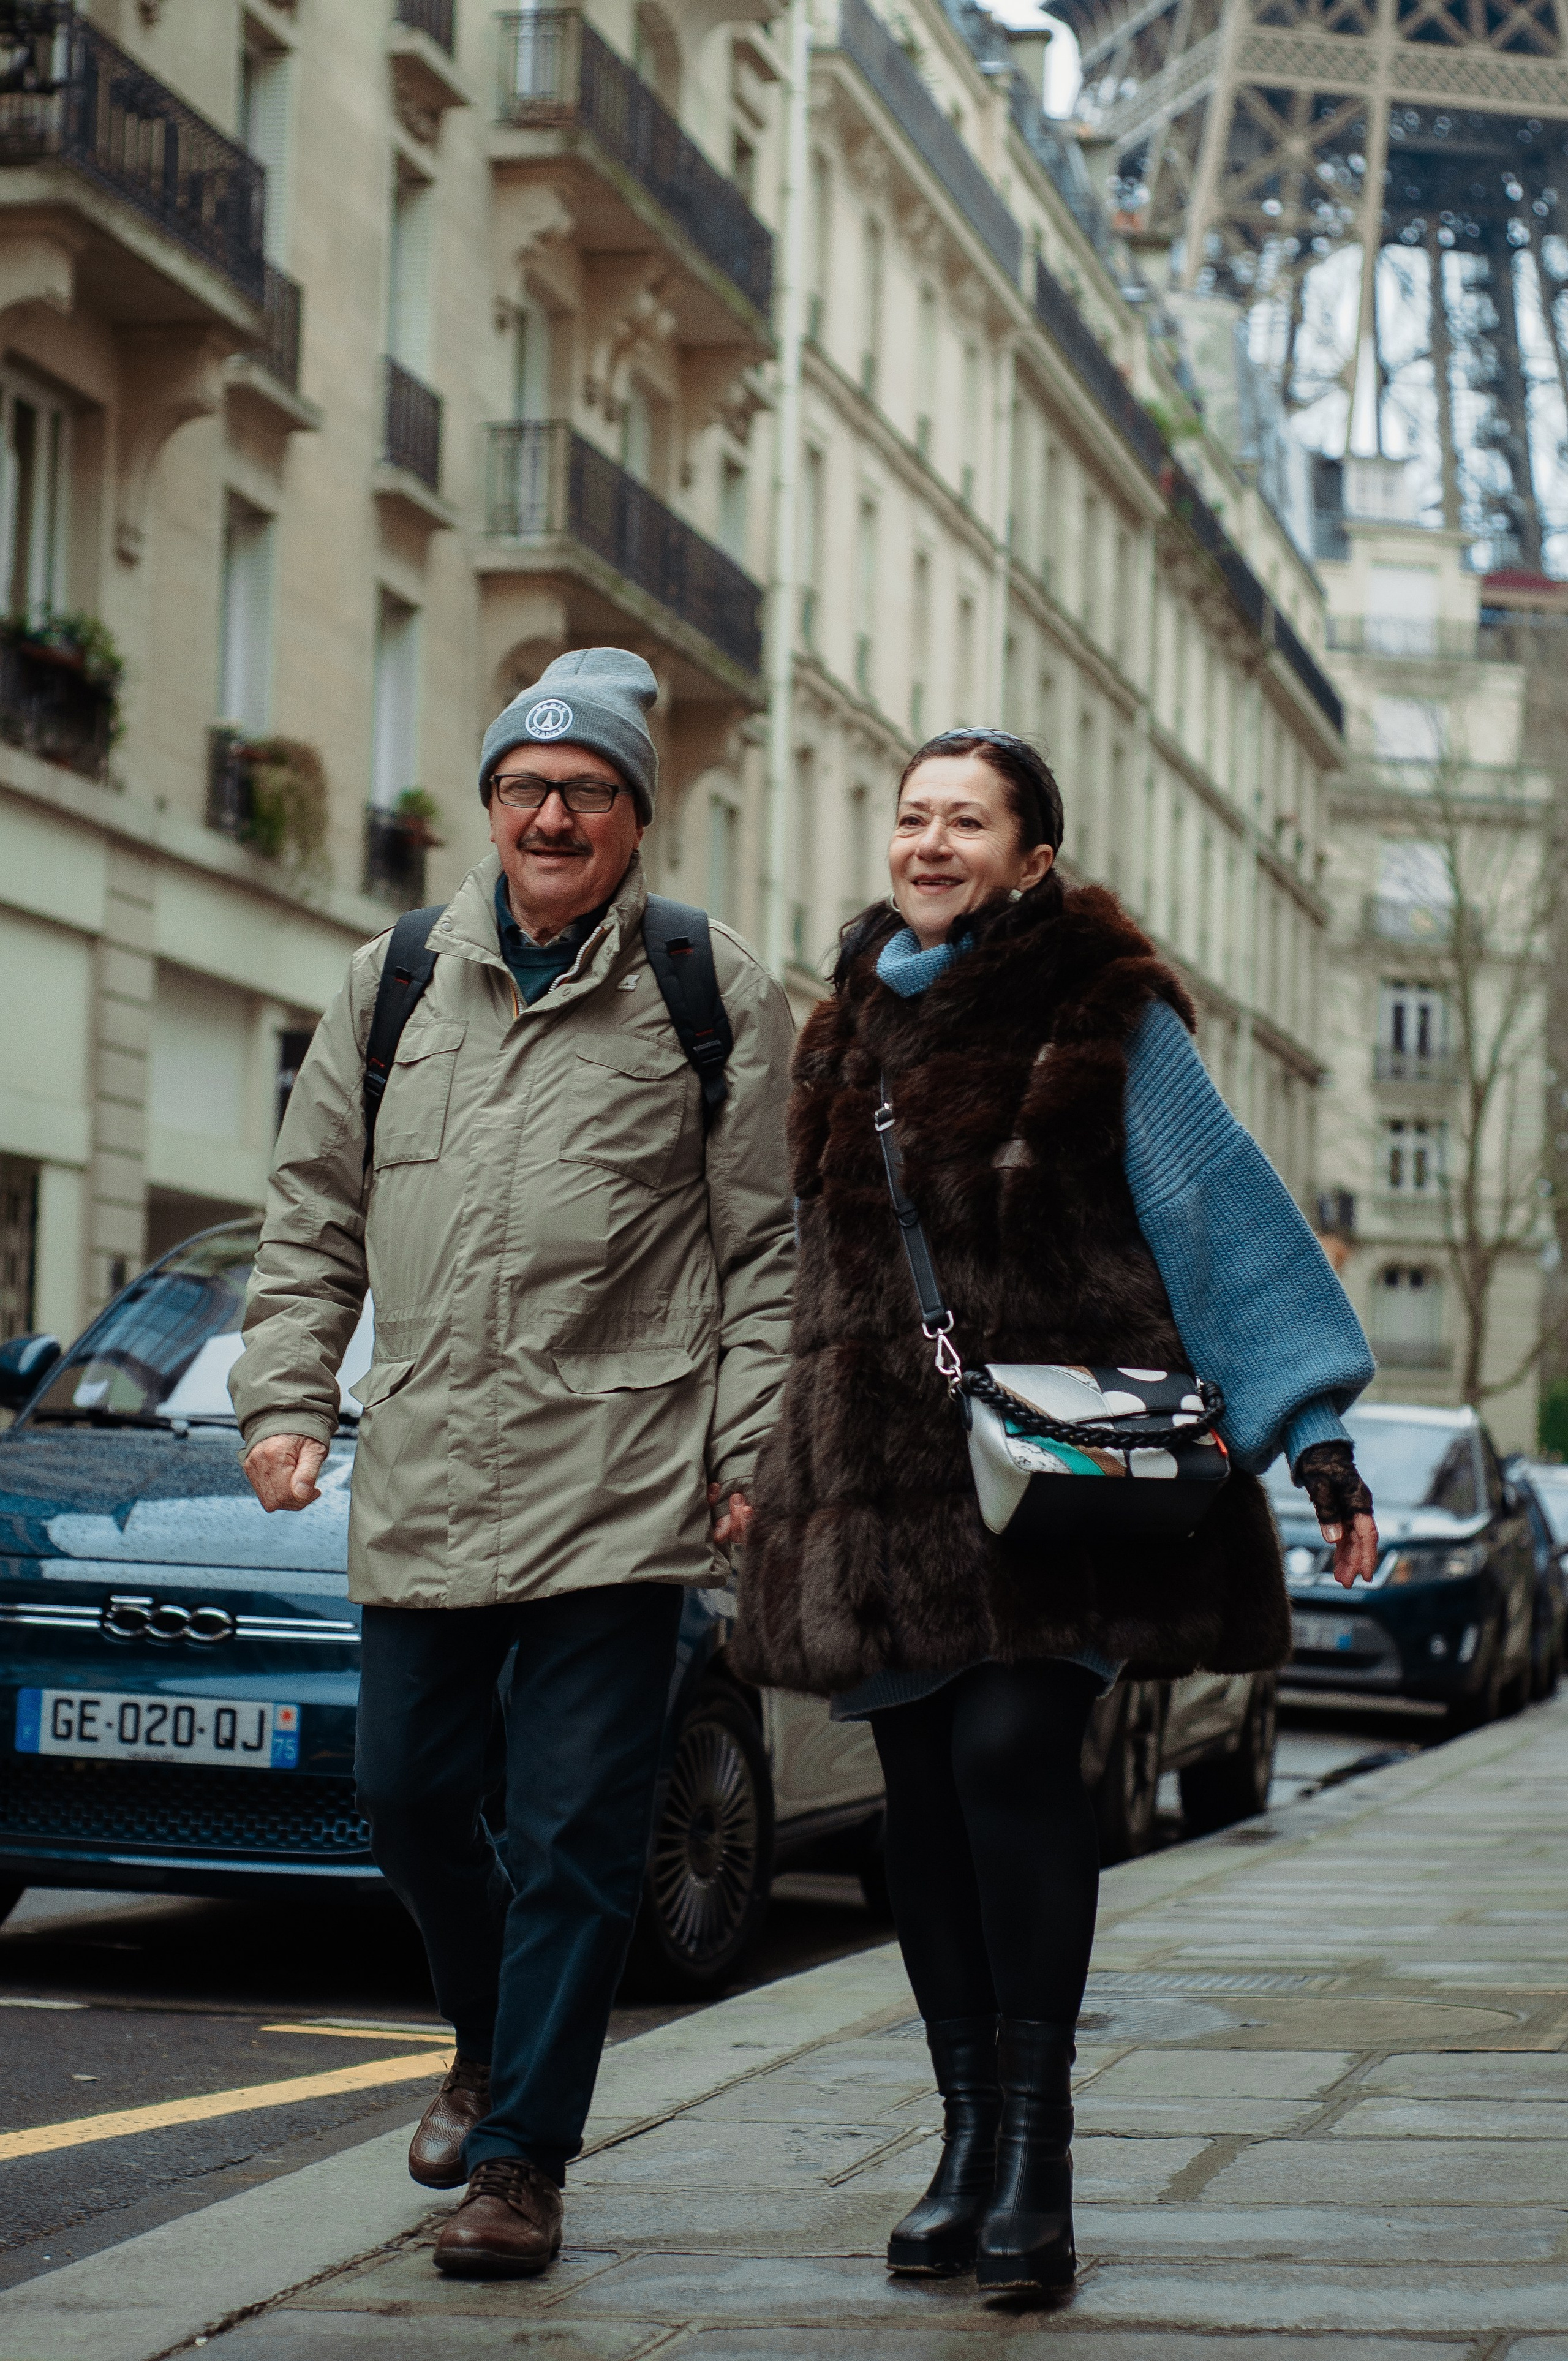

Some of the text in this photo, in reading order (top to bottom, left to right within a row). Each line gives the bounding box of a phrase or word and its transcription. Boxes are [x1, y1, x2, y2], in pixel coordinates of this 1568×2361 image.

[103, 1595, 234, 1641] 500
[51, 1698, 265, 1752] GE-020-QJ
[274, 1738, 295, 1760] 75
